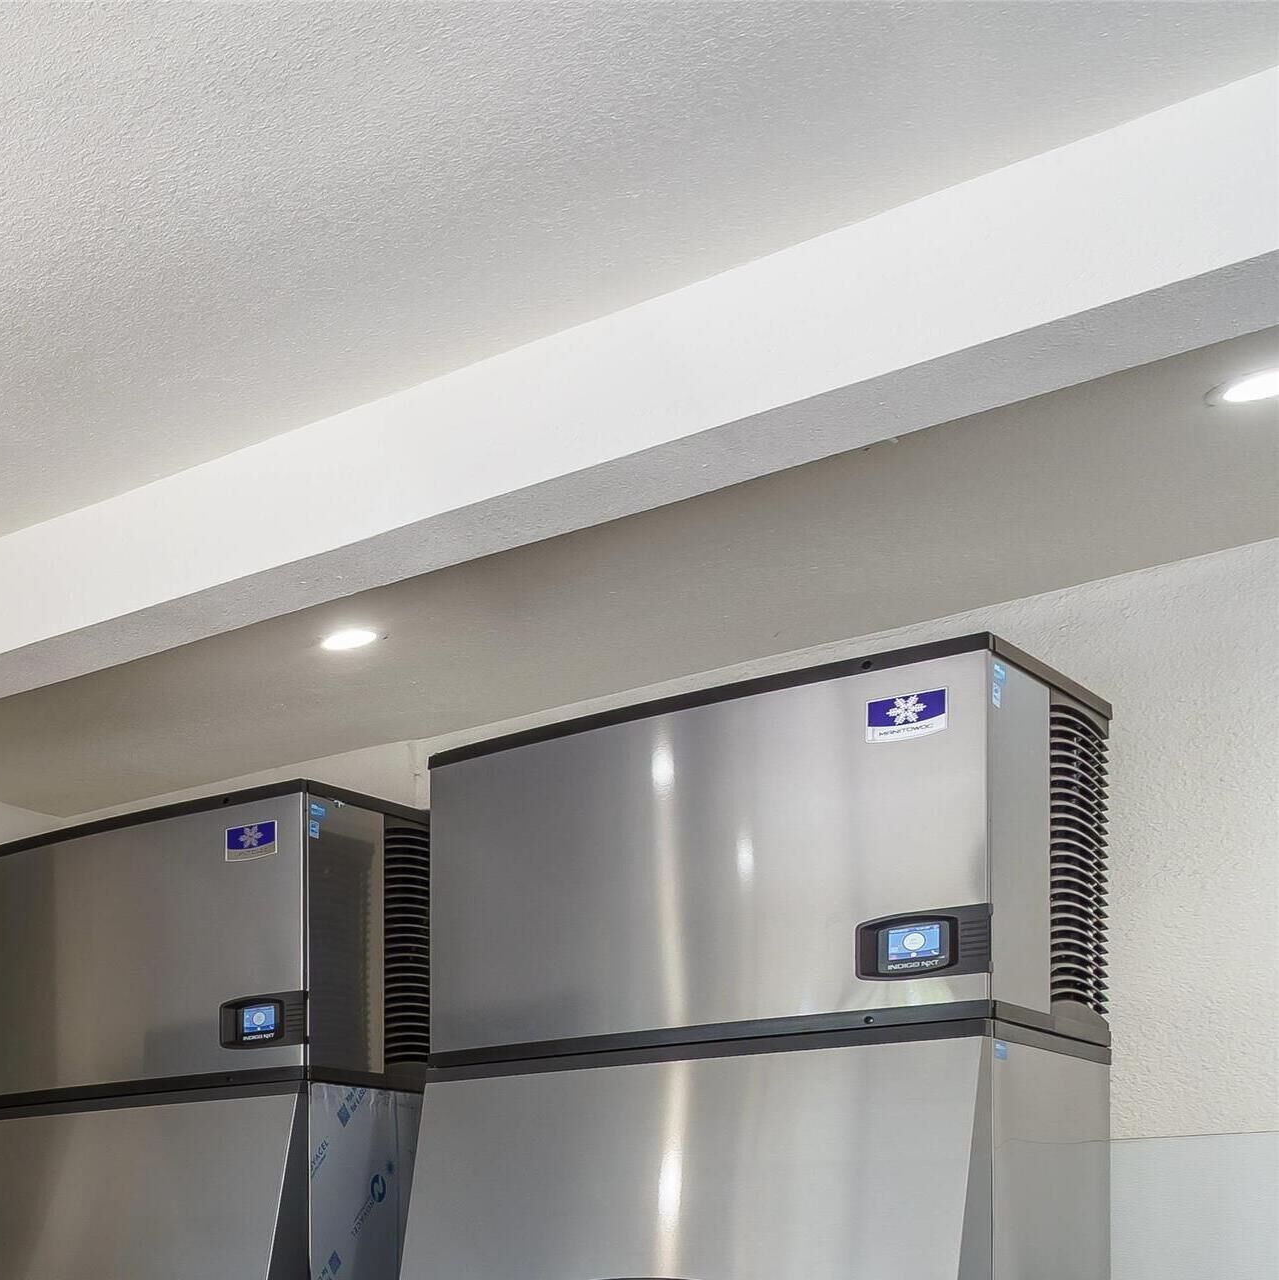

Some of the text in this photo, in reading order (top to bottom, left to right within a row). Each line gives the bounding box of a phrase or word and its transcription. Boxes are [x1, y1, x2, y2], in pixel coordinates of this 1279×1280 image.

[878, 723, 934, 737] MANITOWOC
[887, 958, 939, 970] INDIGO NXT
